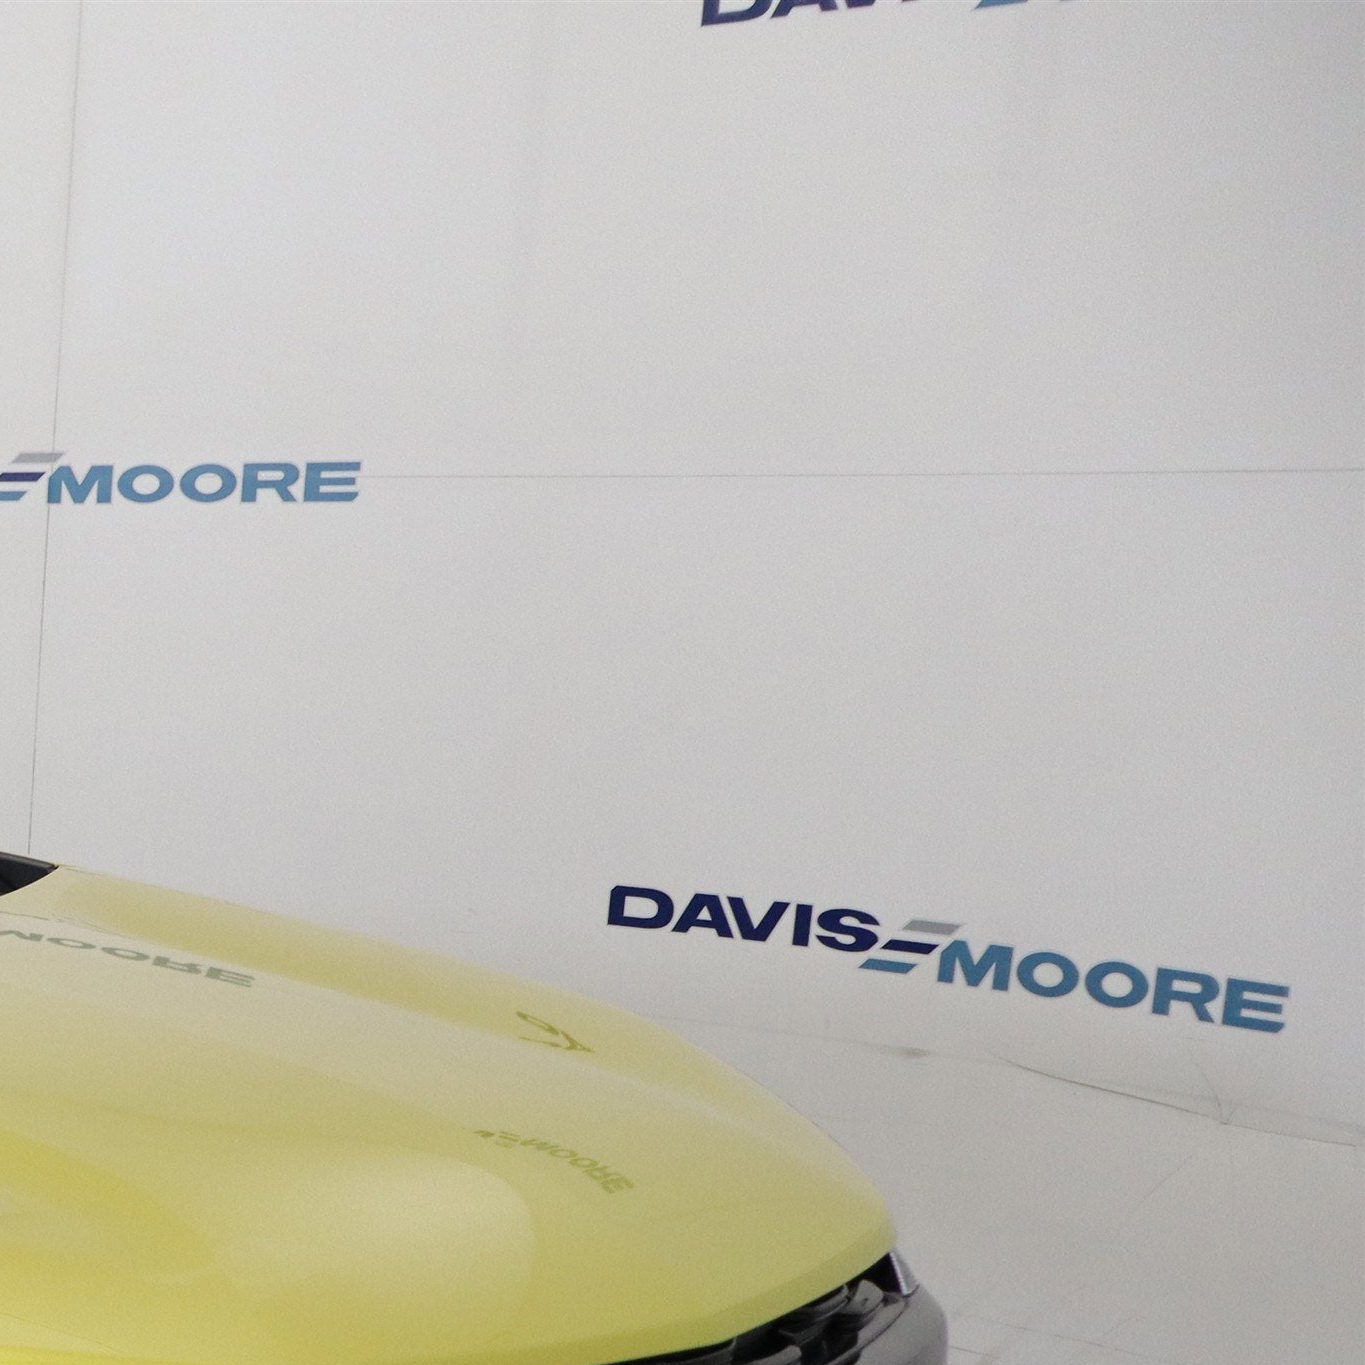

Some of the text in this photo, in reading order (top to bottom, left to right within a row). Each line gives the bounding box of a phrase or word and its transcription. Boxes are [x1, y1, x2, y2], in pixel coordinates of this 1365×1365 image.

[47, 461, 362, 504] MOORE
[606, 884, 1291, 1033] DAVIS MOORE
